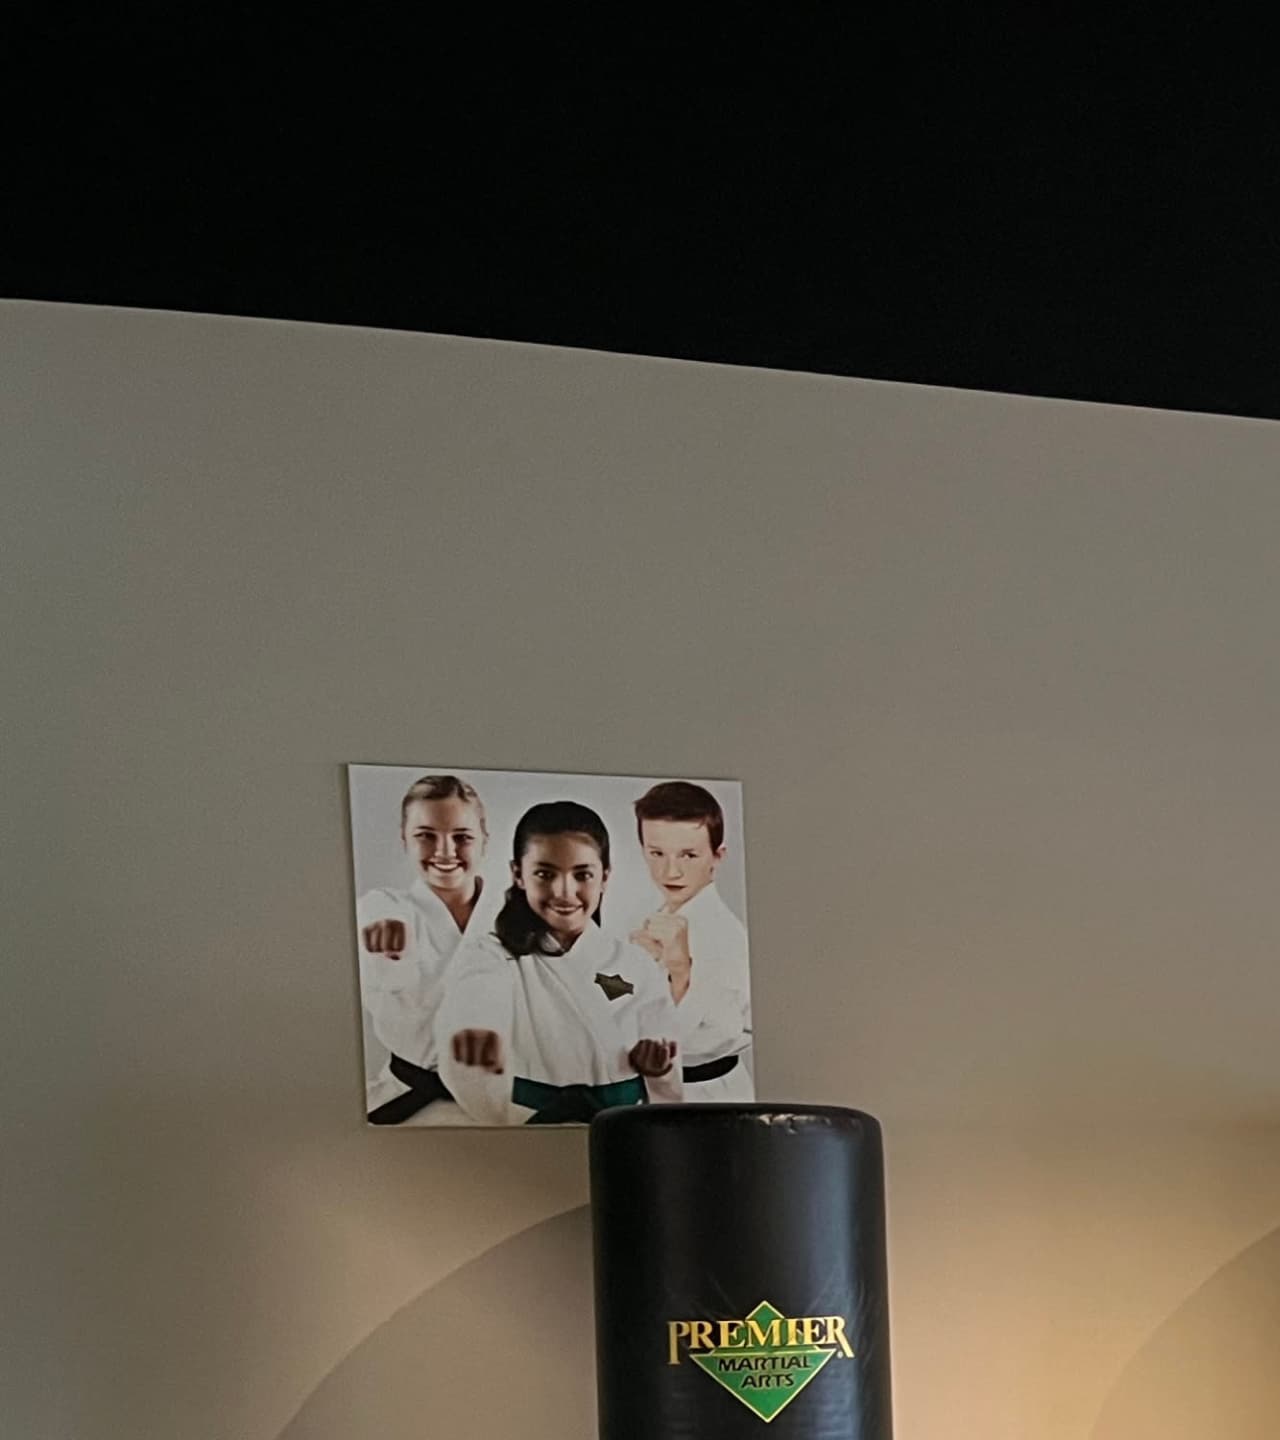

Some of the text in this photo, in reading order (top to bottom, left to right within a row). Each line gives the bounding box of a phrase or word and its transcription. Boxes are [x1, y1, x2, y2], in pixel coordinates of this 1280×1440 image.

[667, 1315, 854, 1365] PREMIER
[718, 1355, 811, 1372] MARTIAL
[740, 1373, 795, 1389] ARTS
